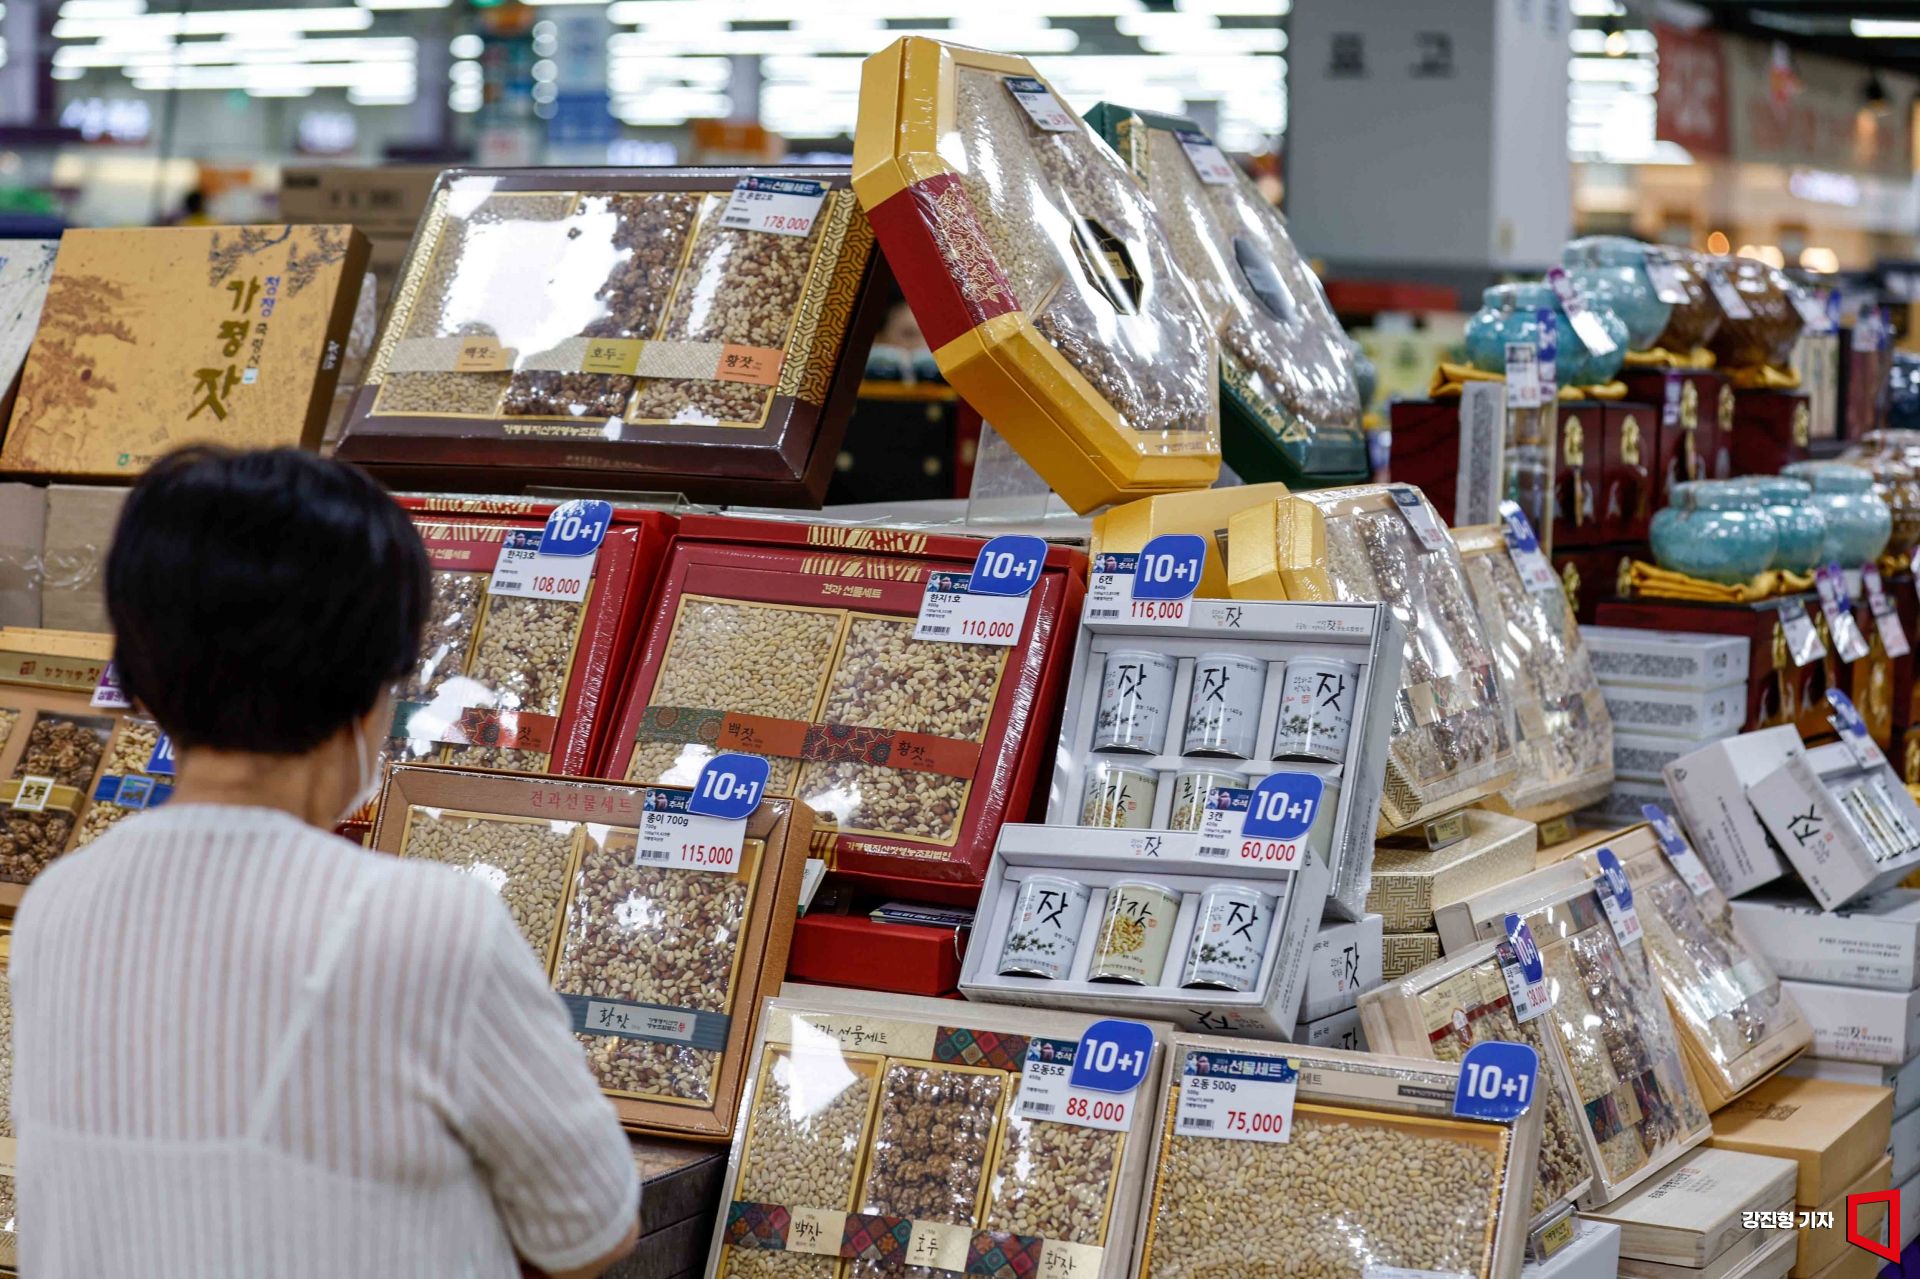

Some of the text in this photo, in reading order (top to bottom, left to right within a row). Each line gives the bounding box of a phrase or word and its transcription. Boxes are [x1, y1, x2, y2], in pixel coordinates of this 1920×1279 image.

[762, 215, 810, 231] 178,000
[187, 276, 260, 421] 가평잣
[724, 353, 754, 371] 황잣
[551, 514, 603, 542] 10+1
[507, 549, 536, 560] 한지3호
[982, 551, 1038, 581] 10+1
[1098, 575, 1114, 585] 6캔
[1143, 554, 1198, 583] 10+1
[532, 576, 580, 595] 108,000
[821, 583, 883, 599] 견과 선물세트
[930, 593, 961, 603] 한지1호
[1131, 601, 1184, 621] 116,000
[1225, 606, 1243, 628] 잣
[962, 619, 1014, 639] 110,000
[1118, 663, 1147, 700] 잣
[1202, 666, 1230, 702] 잣
[1315, 672, 1346, 712] 잣
[727, 722, 756, 743] 백잣
[896, 740, 926, 760] 황잣
[702, 769, 760, 805] 10+1
[530, 790, 633, 813] 견과선물세트
[668, 800, 685, 810] 추석
[1255, 790, 1314, 824] 10+1
[646, 812, 689, 827] 종이 700g
[1207, 811, 1224, 822] 3캔
[1786, 803, 1823, 848] 잣
[681, 844, 734, 865] 115,000
[1143, 836, 1163, 858] 잣
[1241, 841, 1296, 862] 60,000
[1036, 890, 1069, 929] 잣
[1109, 889, 1153, 929] 황잣
[1227, 901, 1259, 942] 잣
[1509, 935, 1540, 966] 10+1
[1343, 941, 1360, 990] 잣
[599, 1006, 630, 1029] 황잣
[1187, 1008, 1240, 1031] 잣
[837, 1025, 889, 1046] 선물세트
[1055, 1050, 1072, 1061] 추석
[1083, 1038, 1145, 1077] 10+1
[1030, 1063, 1066, 1077] 오동5호
[1211, 1059, 1282, 1077] 추석 선물세트
[1301, 1072, 1323, 1086] 세트
[1190, 1078, 1237, 1092] 오동 500g
[1466, 1063, 1529, 1103] 10+1
[1066, 1097, 1125, 1122] 88,000
[1226, 1110, 1284, 1134] 75,000
[794, 1219, 823, 1242] 백잣
[915, 1233, 939, 1257] 호두
[1044, 1250, 1077, 1276] 황잣
